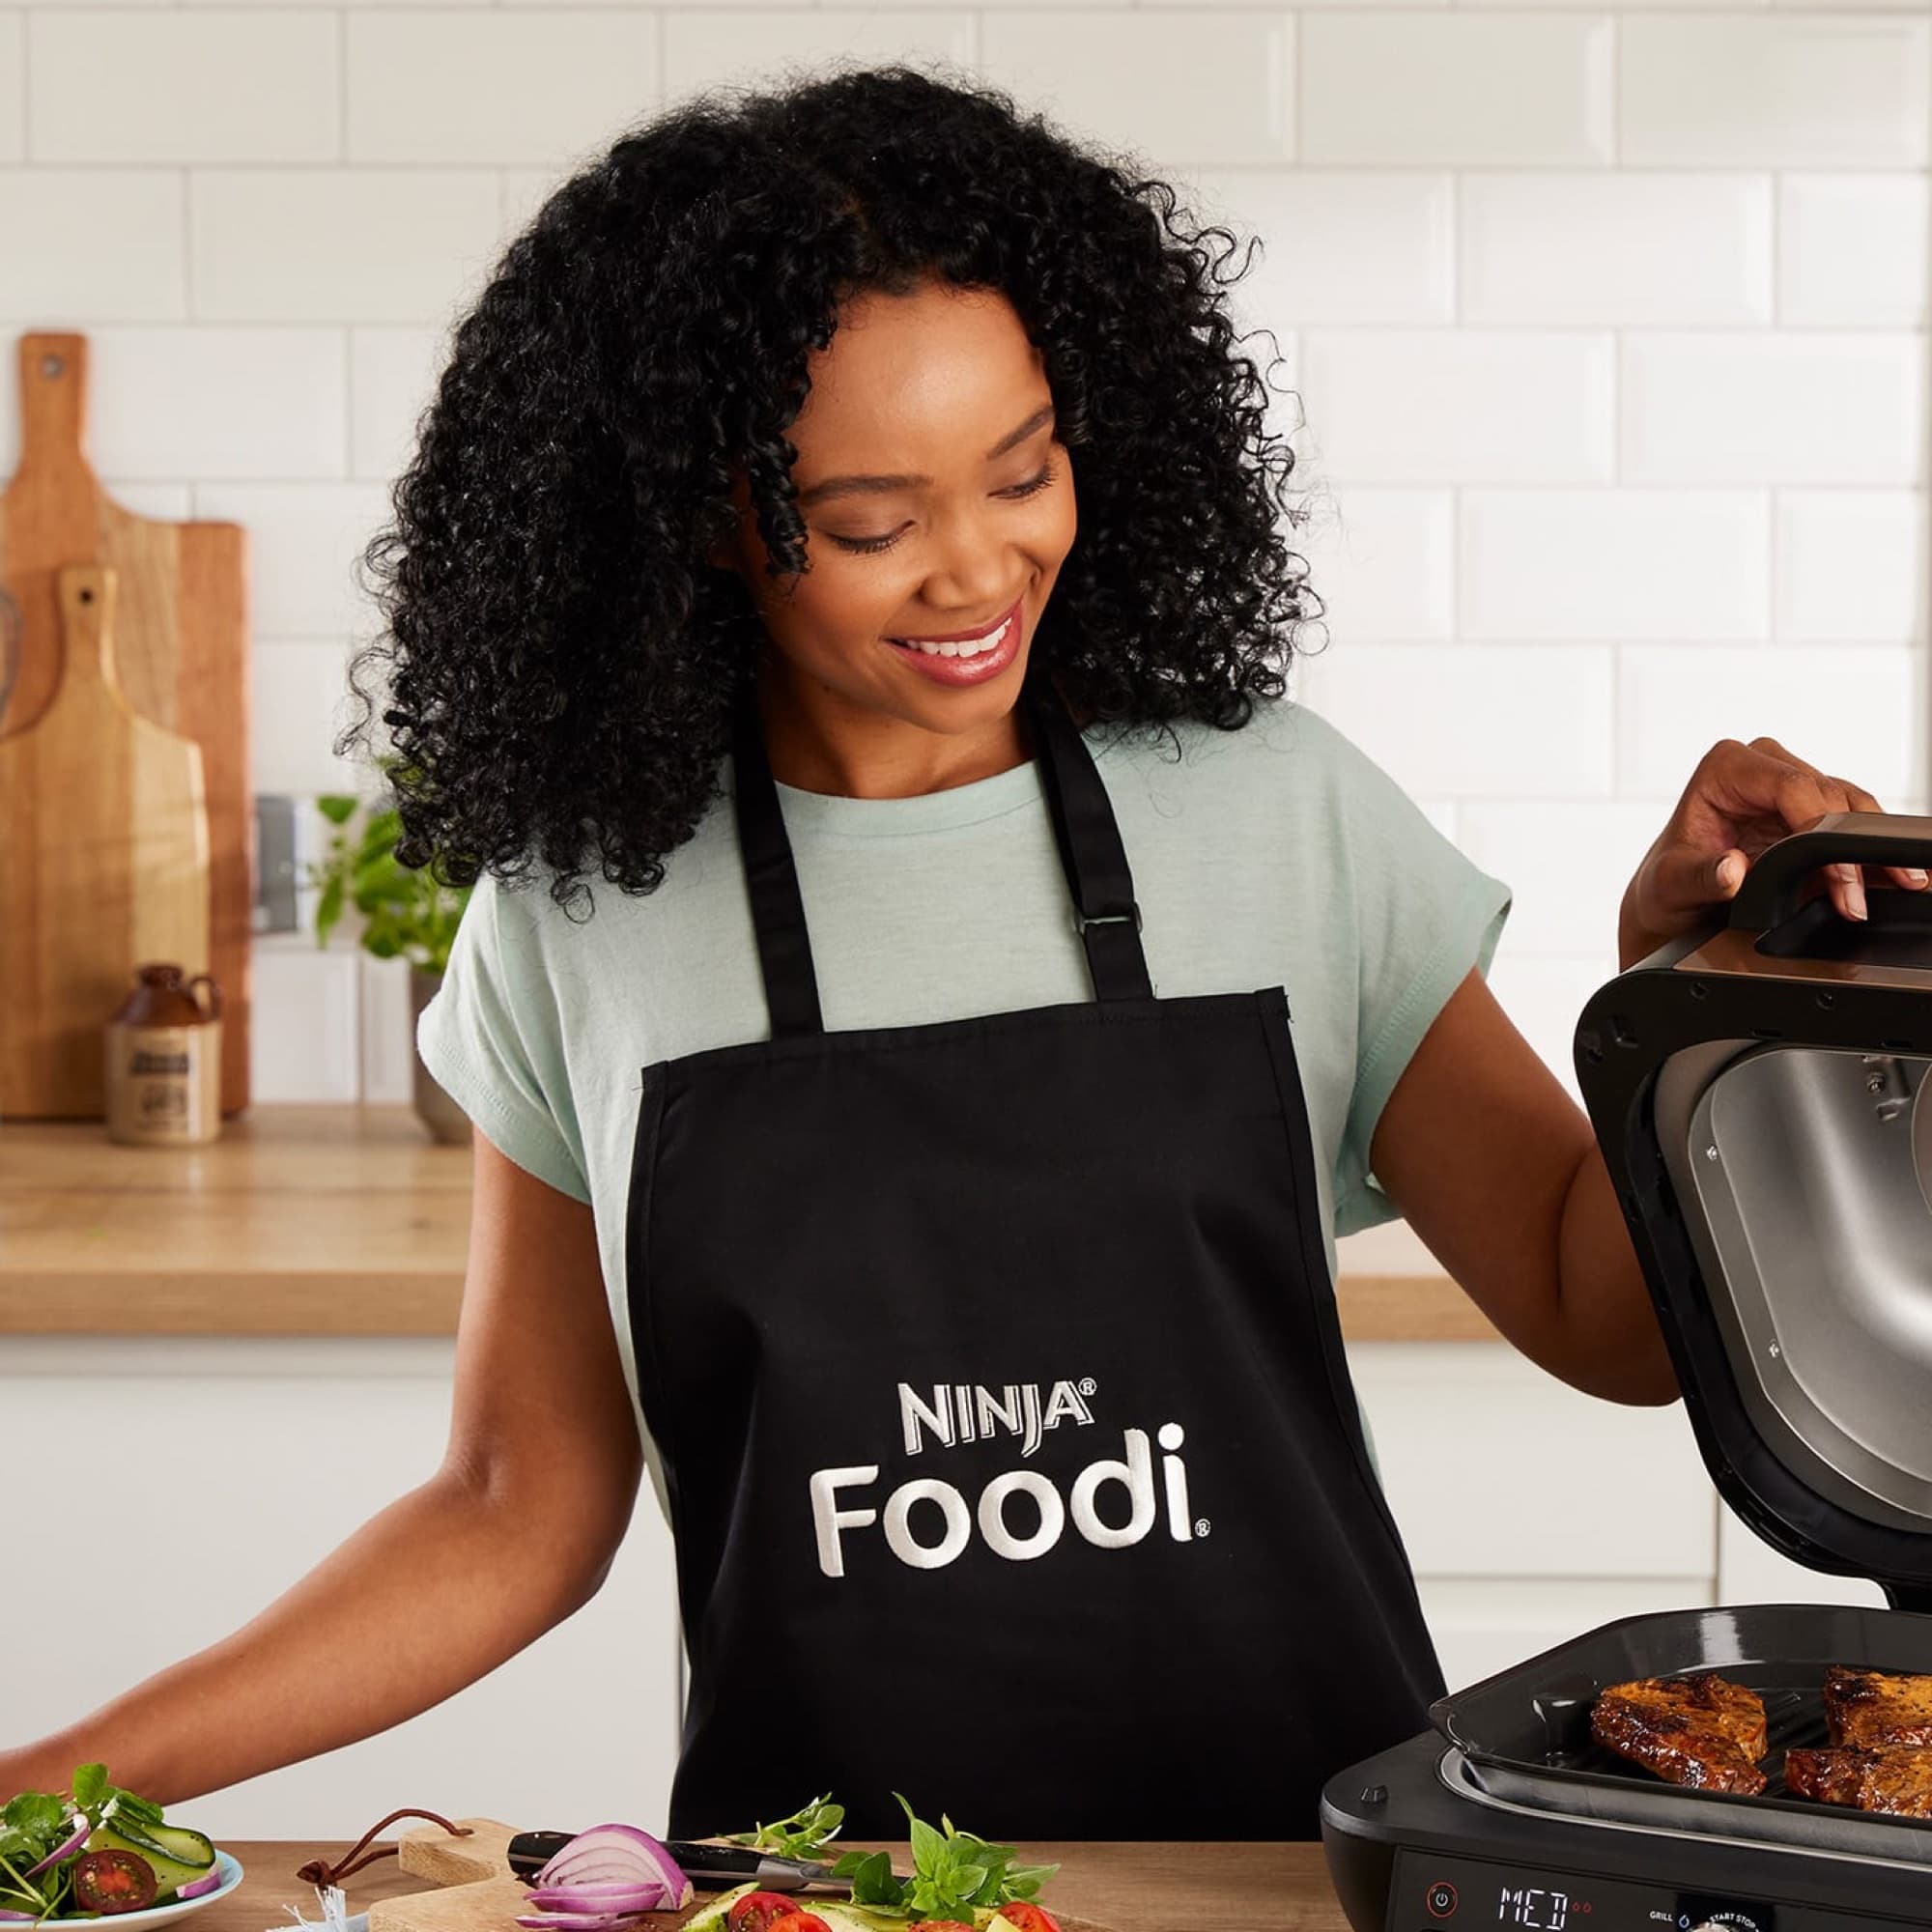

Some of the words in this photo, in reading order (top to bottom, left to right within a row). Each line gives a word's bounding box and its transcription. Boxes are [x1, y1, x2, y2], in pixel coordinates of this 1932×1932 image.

[1499, 1887, 1568, 1930] MED
[1649, 1910, 1673, 1922] GRILL
[1709, 1912, 1735, 1923] START
